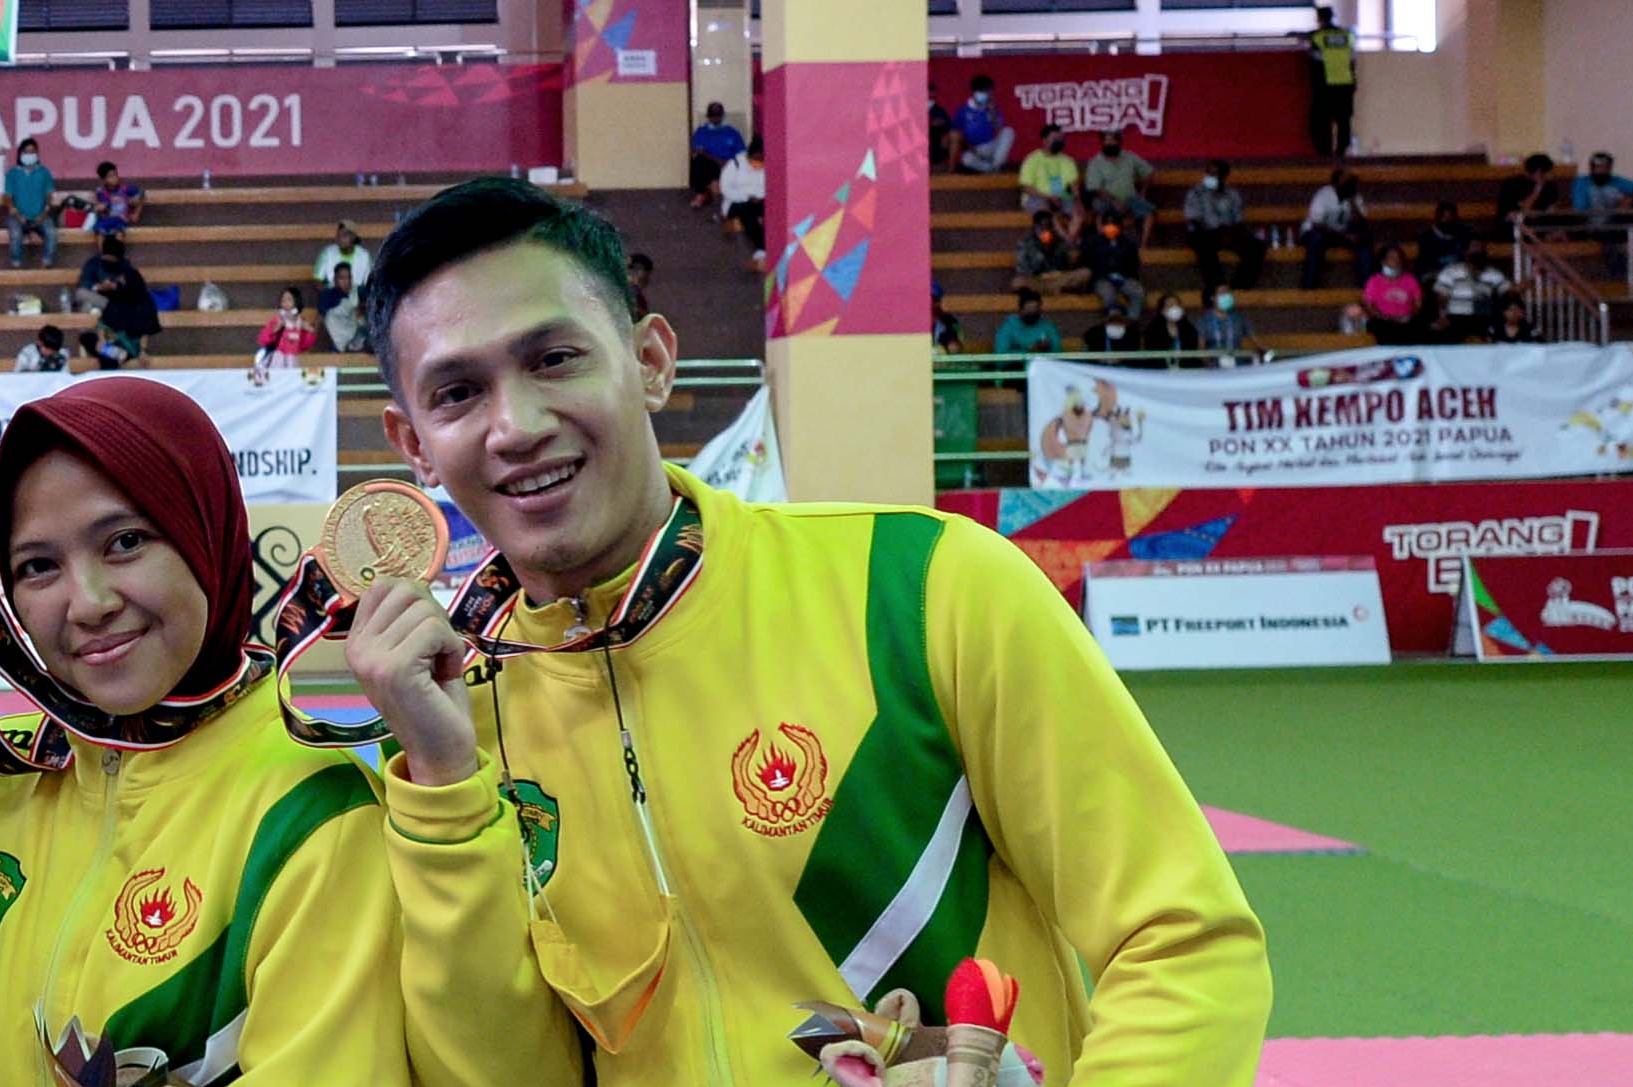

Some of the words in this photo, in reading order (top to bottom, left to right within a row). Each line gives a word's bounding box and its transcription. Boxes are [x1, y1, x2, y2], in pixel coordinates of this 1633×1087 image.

[173, 93, 302, 150] 2021
[1224, 398, 1284, 433] TIM
[1294, 387, 1405, 429] KEMPO
[1416, 386, 1498, 420] ACEH
[1209, 438, 1256, 456] PON
[1263, 435, 1293, 453] XX
[1301, 431, 1376, 452] TAHUN
[1383, 427, 1431, 447] 2021
[1438, 427, 1513, 444] PAPUA
[232, 448, 317, 477] NDSHIP.
[1146, 618, 1168, 632] PT
